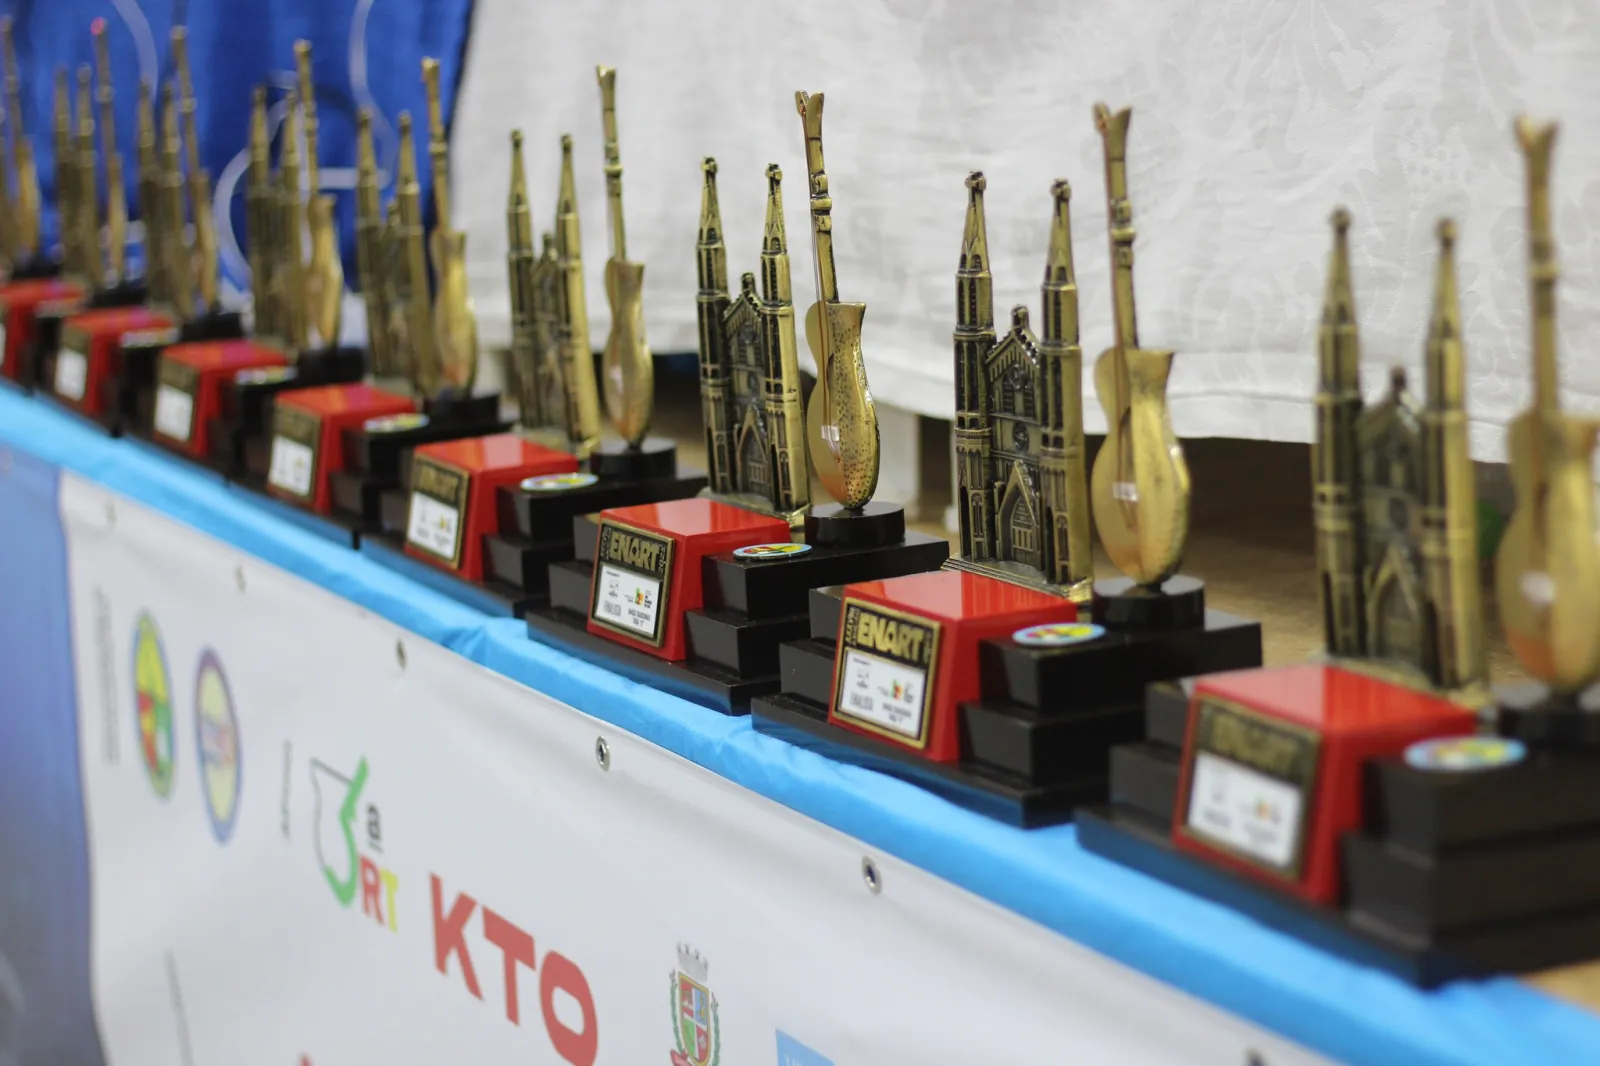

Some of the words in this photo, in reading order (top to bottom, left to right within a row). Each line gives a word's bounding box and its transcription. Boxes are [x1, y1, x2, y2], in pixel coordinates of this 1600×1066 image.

[609, 530, 660, 572] ENART
[857, 612, 925, 662] ENART
[428, 871, 599, 1066] KTO
